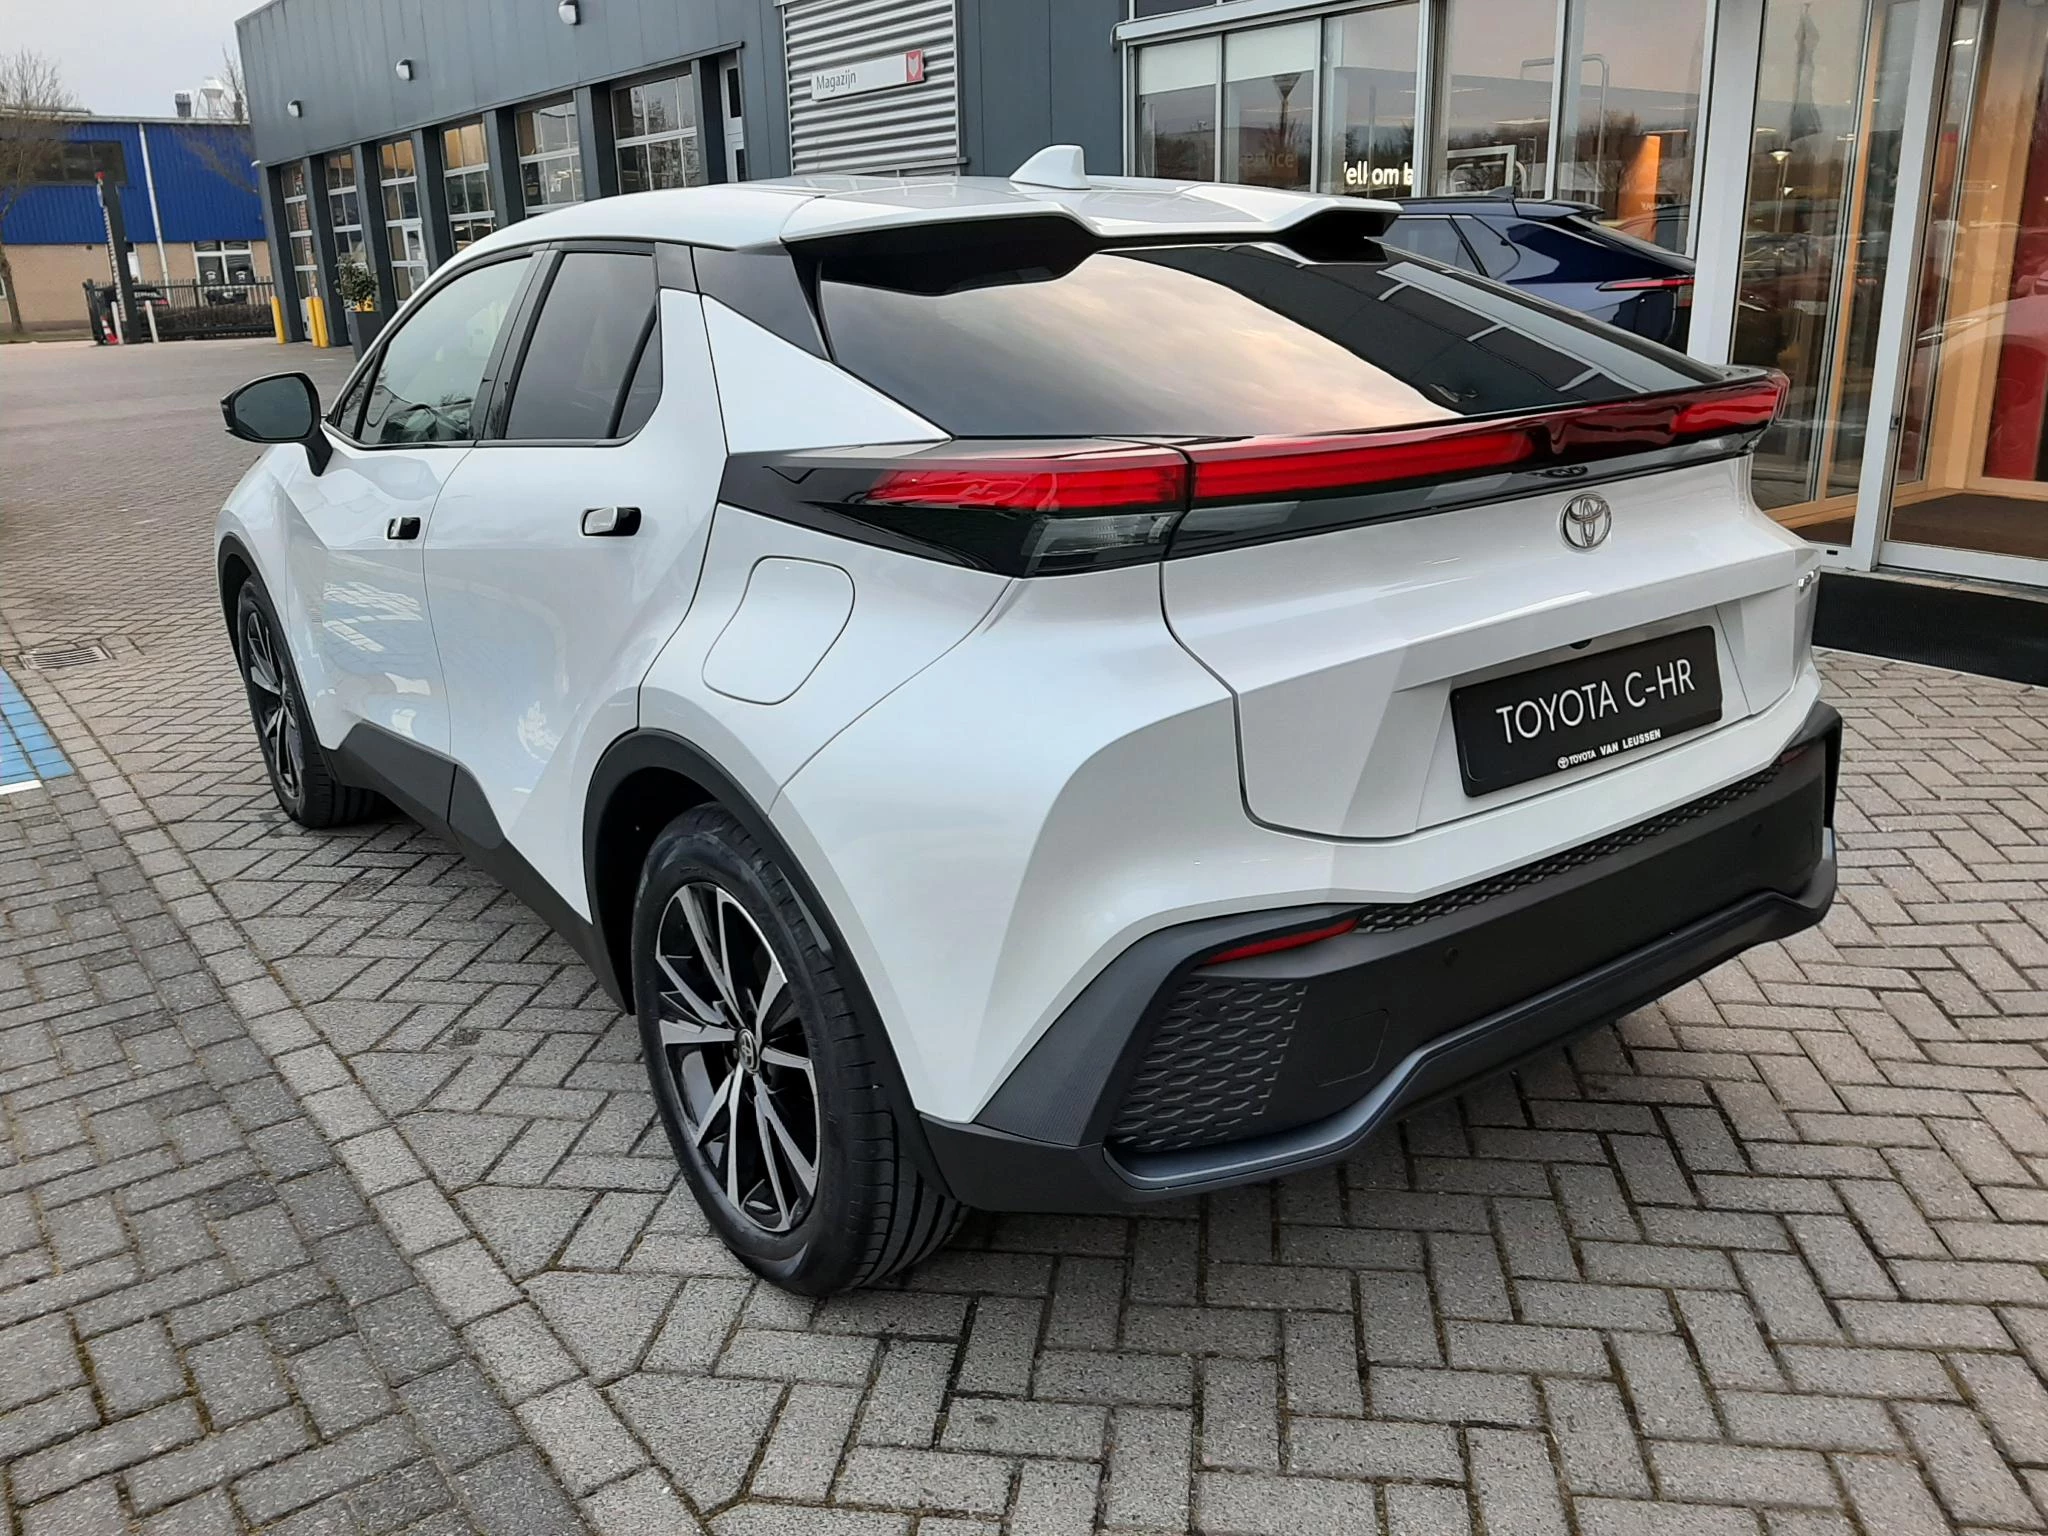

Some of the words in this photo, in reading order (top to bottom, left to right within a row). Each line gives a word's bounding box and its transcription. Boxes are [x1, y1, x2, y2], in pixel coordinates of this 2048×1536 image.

[816, 69, 857, 92] Magazijn
[1240, 150, 1295, 169] ervice
[1496, 680, 1619, 743] TOYOTA
[1624, 658, 1695, 708] C-HR
[1568, 749, 1597, 765] TOYOTA
[1600, 742, 1619, 756] VAN
[1622, 728, 1661, 750] LEUSSEN
